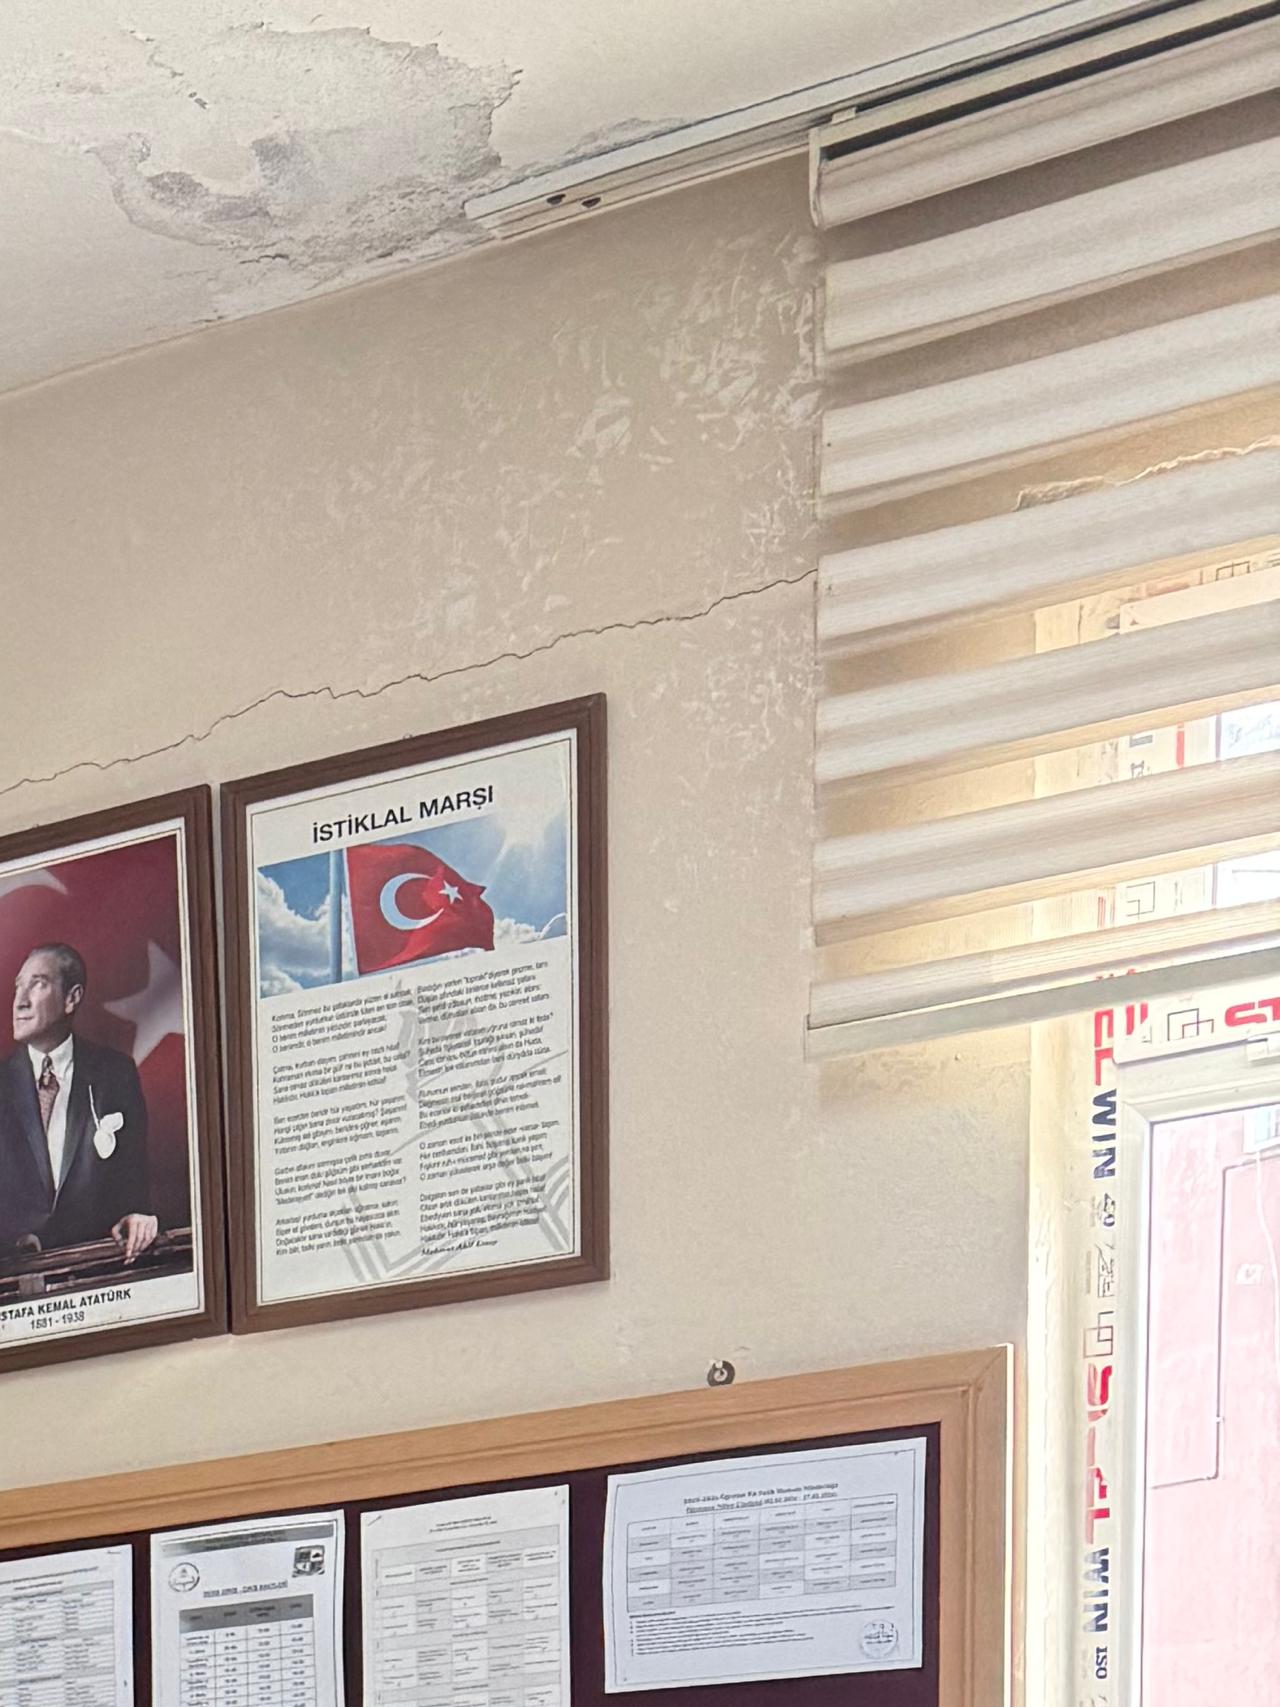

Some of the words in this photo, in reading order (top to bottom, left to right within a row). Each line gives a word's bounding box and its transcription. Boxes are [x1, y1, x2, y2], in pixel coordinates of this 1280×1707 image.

[313, 806, 413, 844] İSTİKLAL
[419, 785, 494, 820] MARŞI
[37, 1298, 77, 1318] KEMAL
[79, 1287, 132, 1307] ATATÜRK
